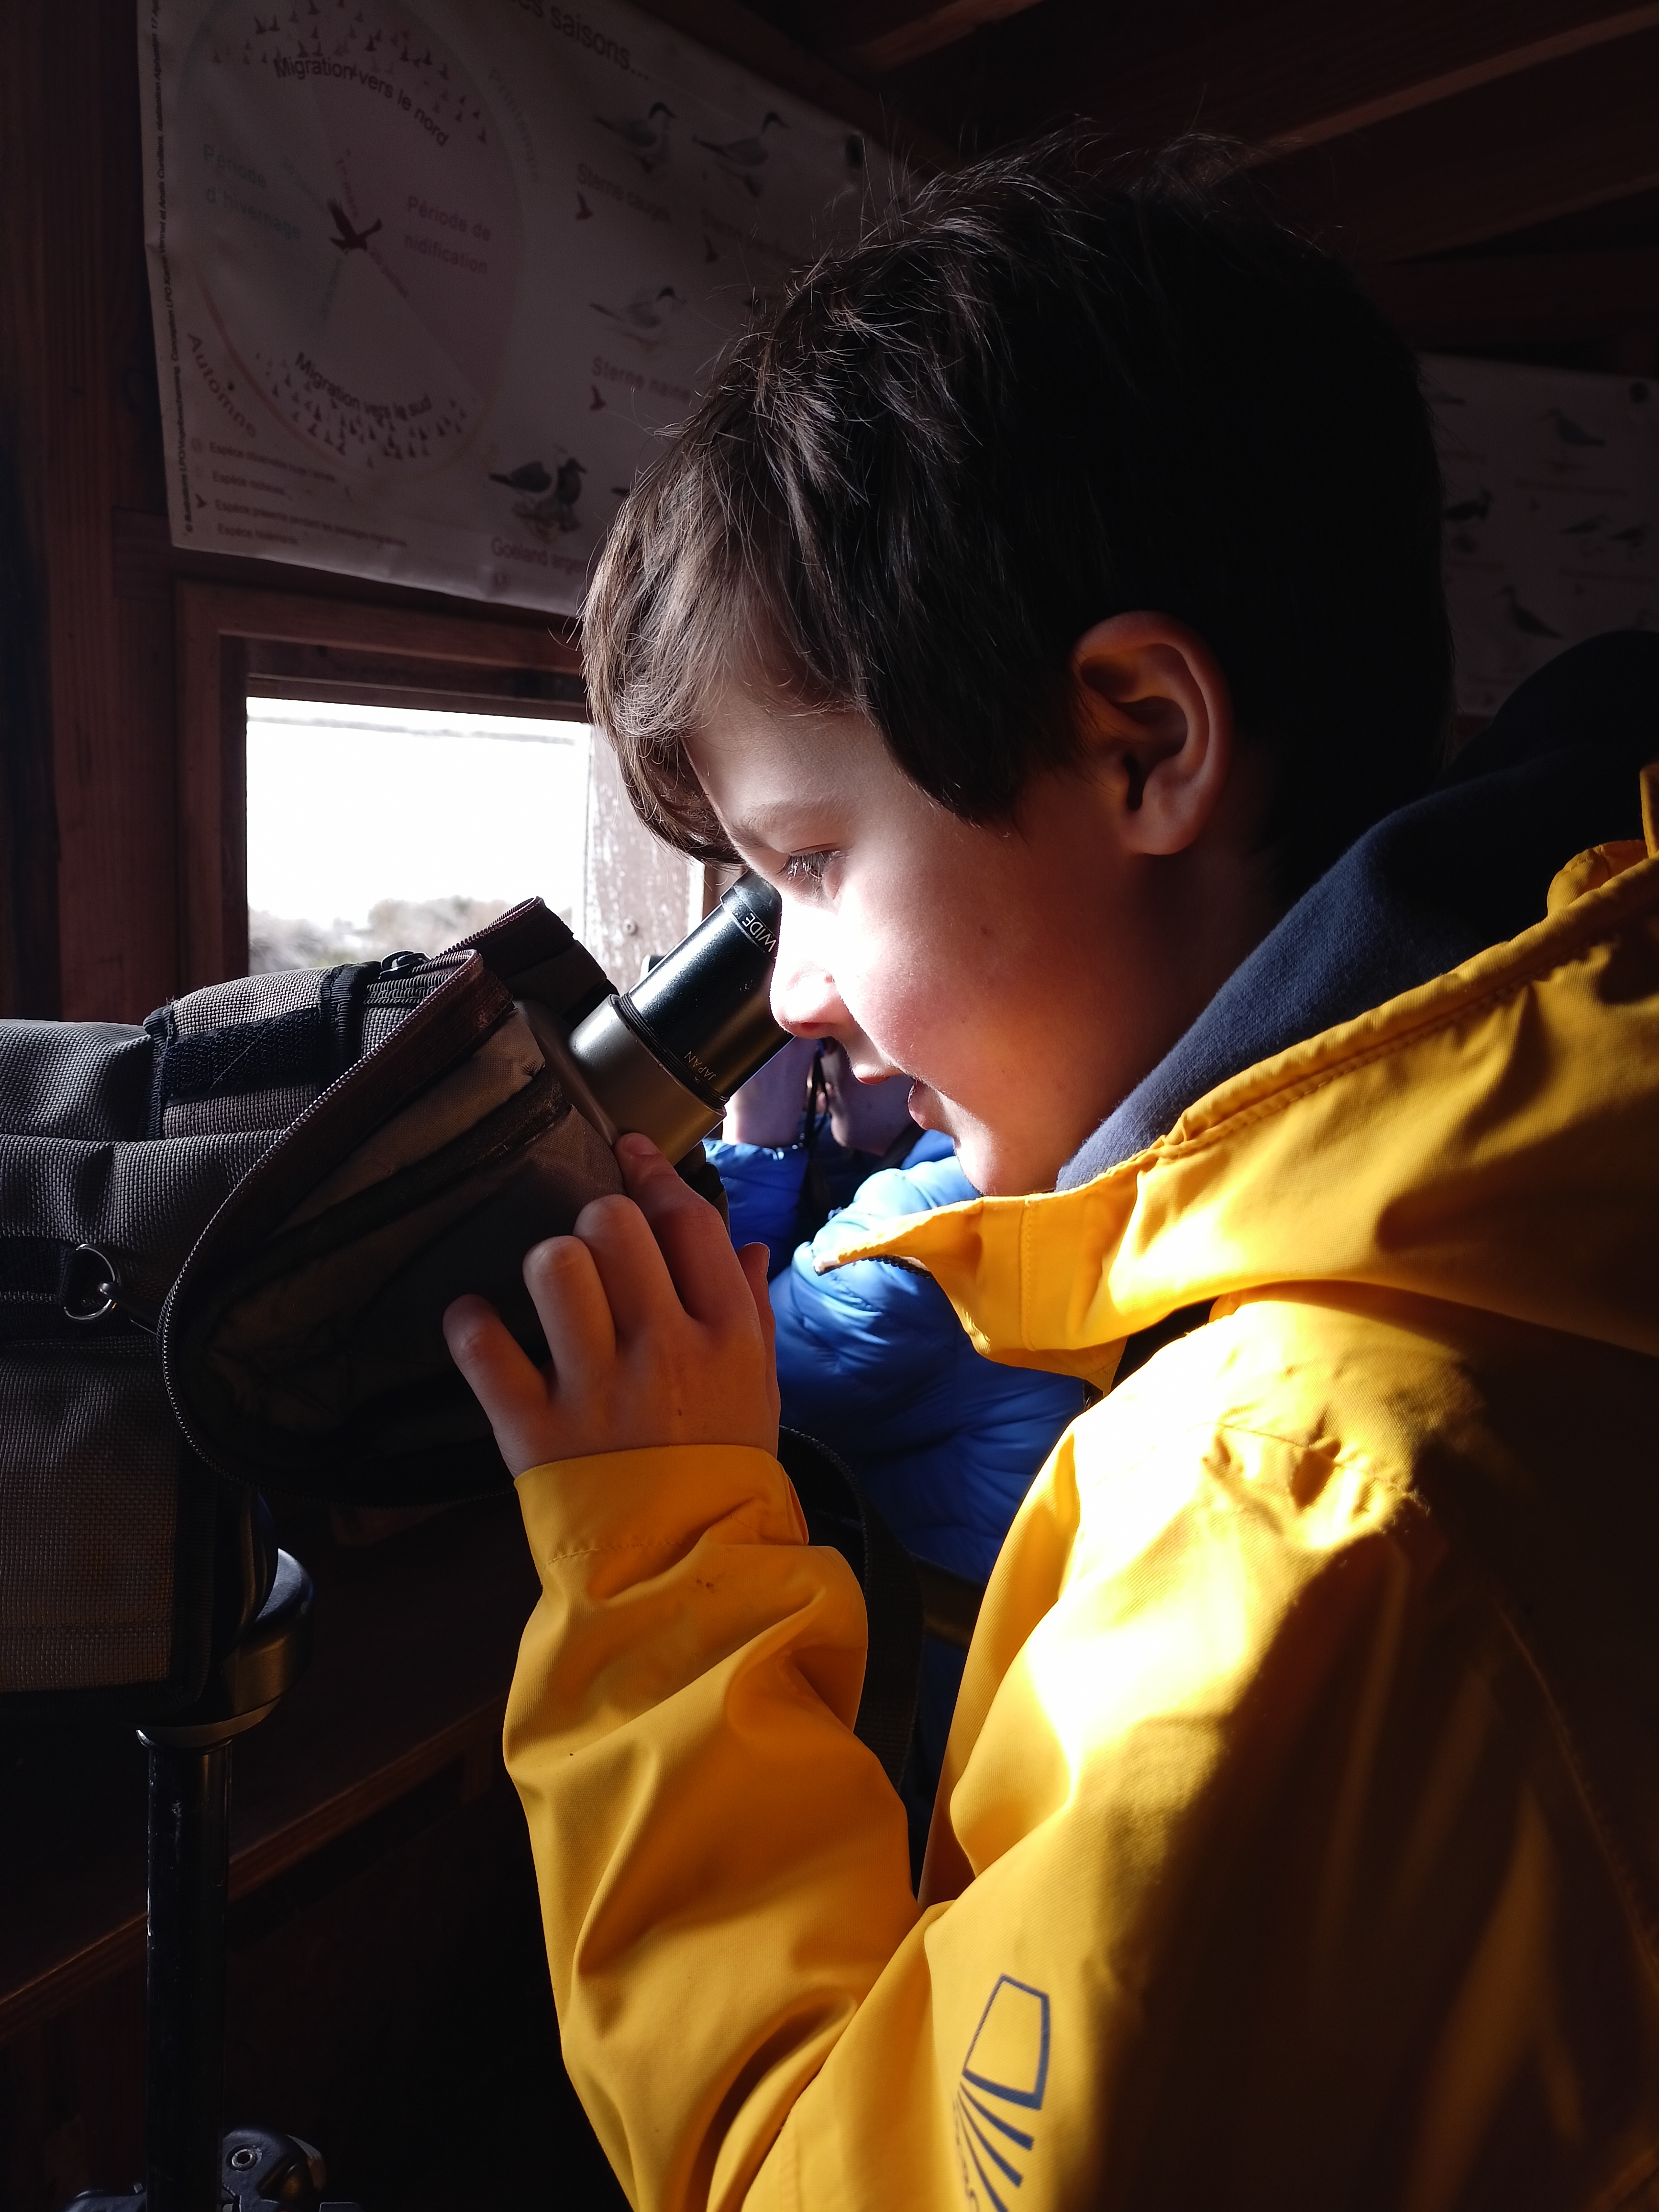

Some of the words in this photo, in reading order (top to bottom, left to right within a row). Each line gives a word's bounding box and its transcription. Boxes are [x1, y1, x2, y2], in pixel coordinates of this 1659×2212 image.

[273, 57, 353, 80] Migration
[359, 70, 393, 99] vers
[397, 88, 411, 111] le
[414, 107, 449, 147] nord
[407, 195, 468, 232] Période
[472, 220, 491, 242] de
[404, 234, 487, 275] nidification
[188, 333, 257, 438] Automne
[742, 913, 777, 953] WIDE
[684, 1051, 717, 1081] JAPAN
